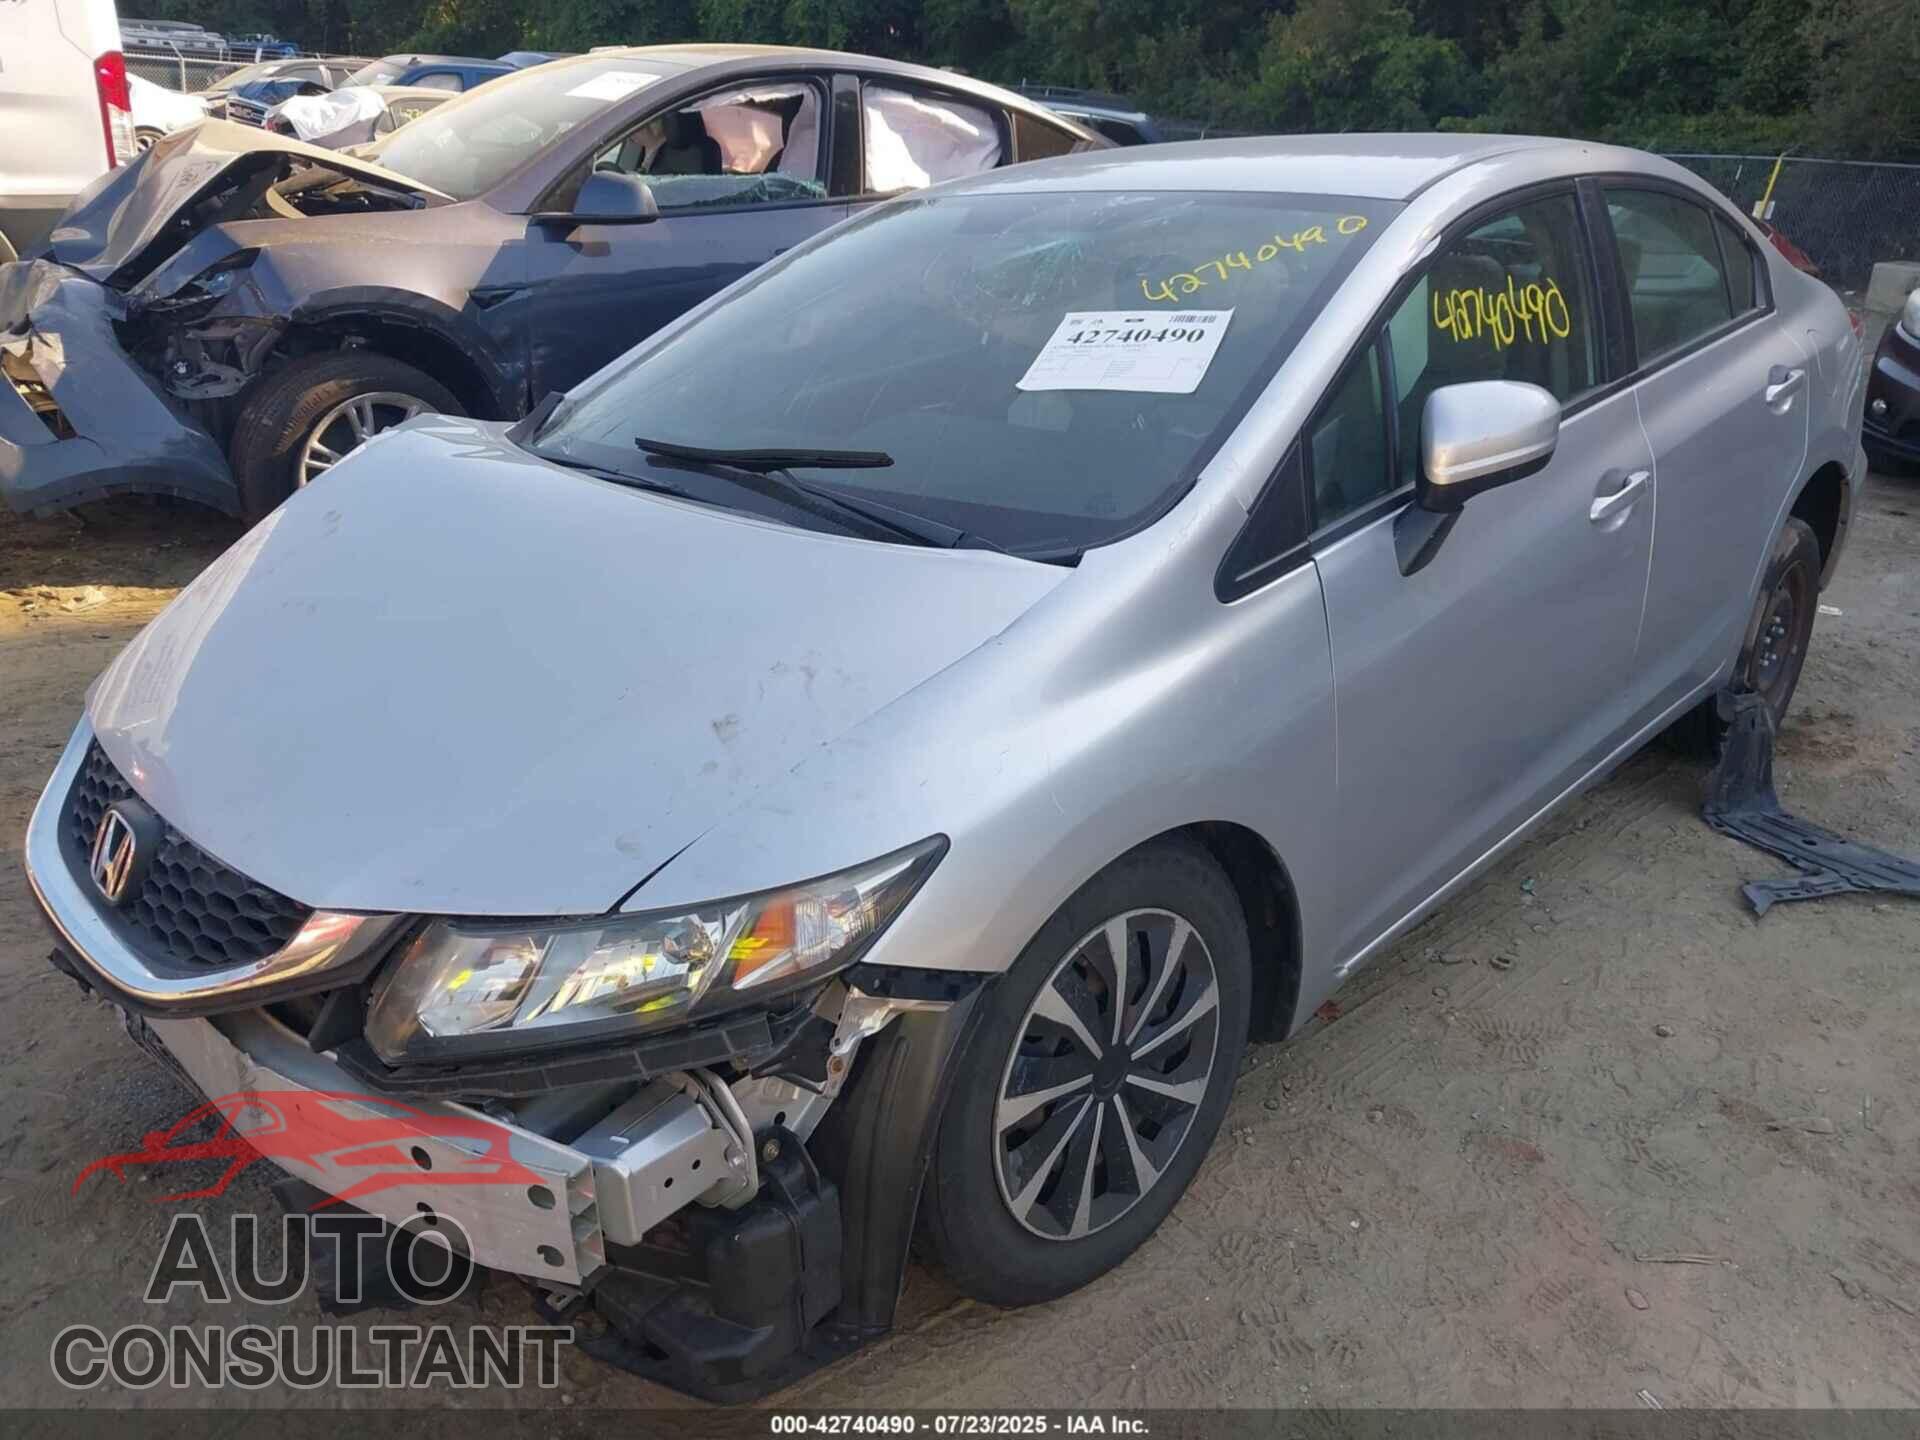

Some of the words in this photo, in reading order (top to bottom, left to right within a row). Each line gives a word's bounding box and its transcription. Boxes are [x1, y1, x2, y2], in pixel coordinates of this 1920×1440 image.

[1142, 214, 1368, 303] 42740490
[1066, 328, 1205, 344] 42740490
[1432, 274, 1571, 351] 42740490
